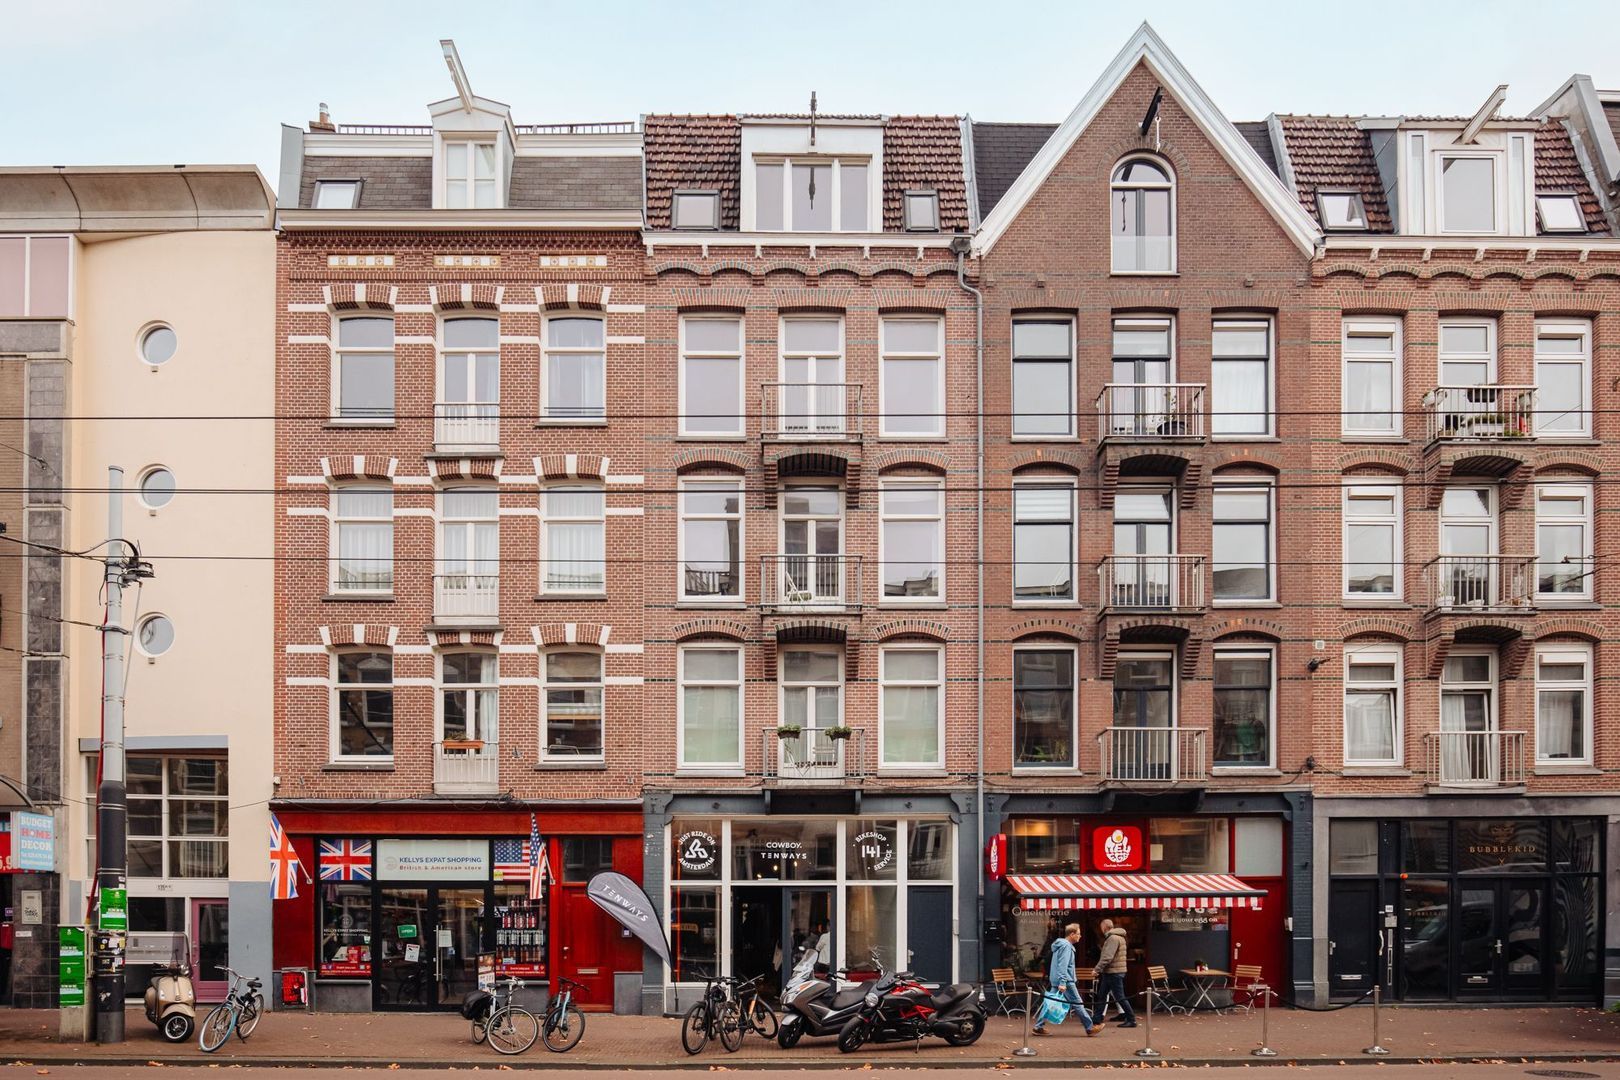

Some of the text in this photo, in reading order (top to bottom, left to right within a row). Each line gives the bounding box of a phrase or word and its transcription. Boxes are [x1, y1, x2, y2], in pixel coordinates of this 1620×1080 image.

[21, 815, 52, 829] BUDGET
[678, 830, 716, 846] JUST RIDE ON
[855, 831, 887, 843] BIKESHOP
[21, 839, 51, 851] DECOR
[861, 845, 881, 858] 141
[1469, 845, 1536, 853] BUBBLEKID
[760, 852, 807, 860] TENWAYS
[873, 849, 893, 871] SERVICE
[678, 857, 716, 870] AMSTERDAM
[602, 884, 649, 922] TENWAYS
[1011, 906, 1070, 917] Omeletterie
